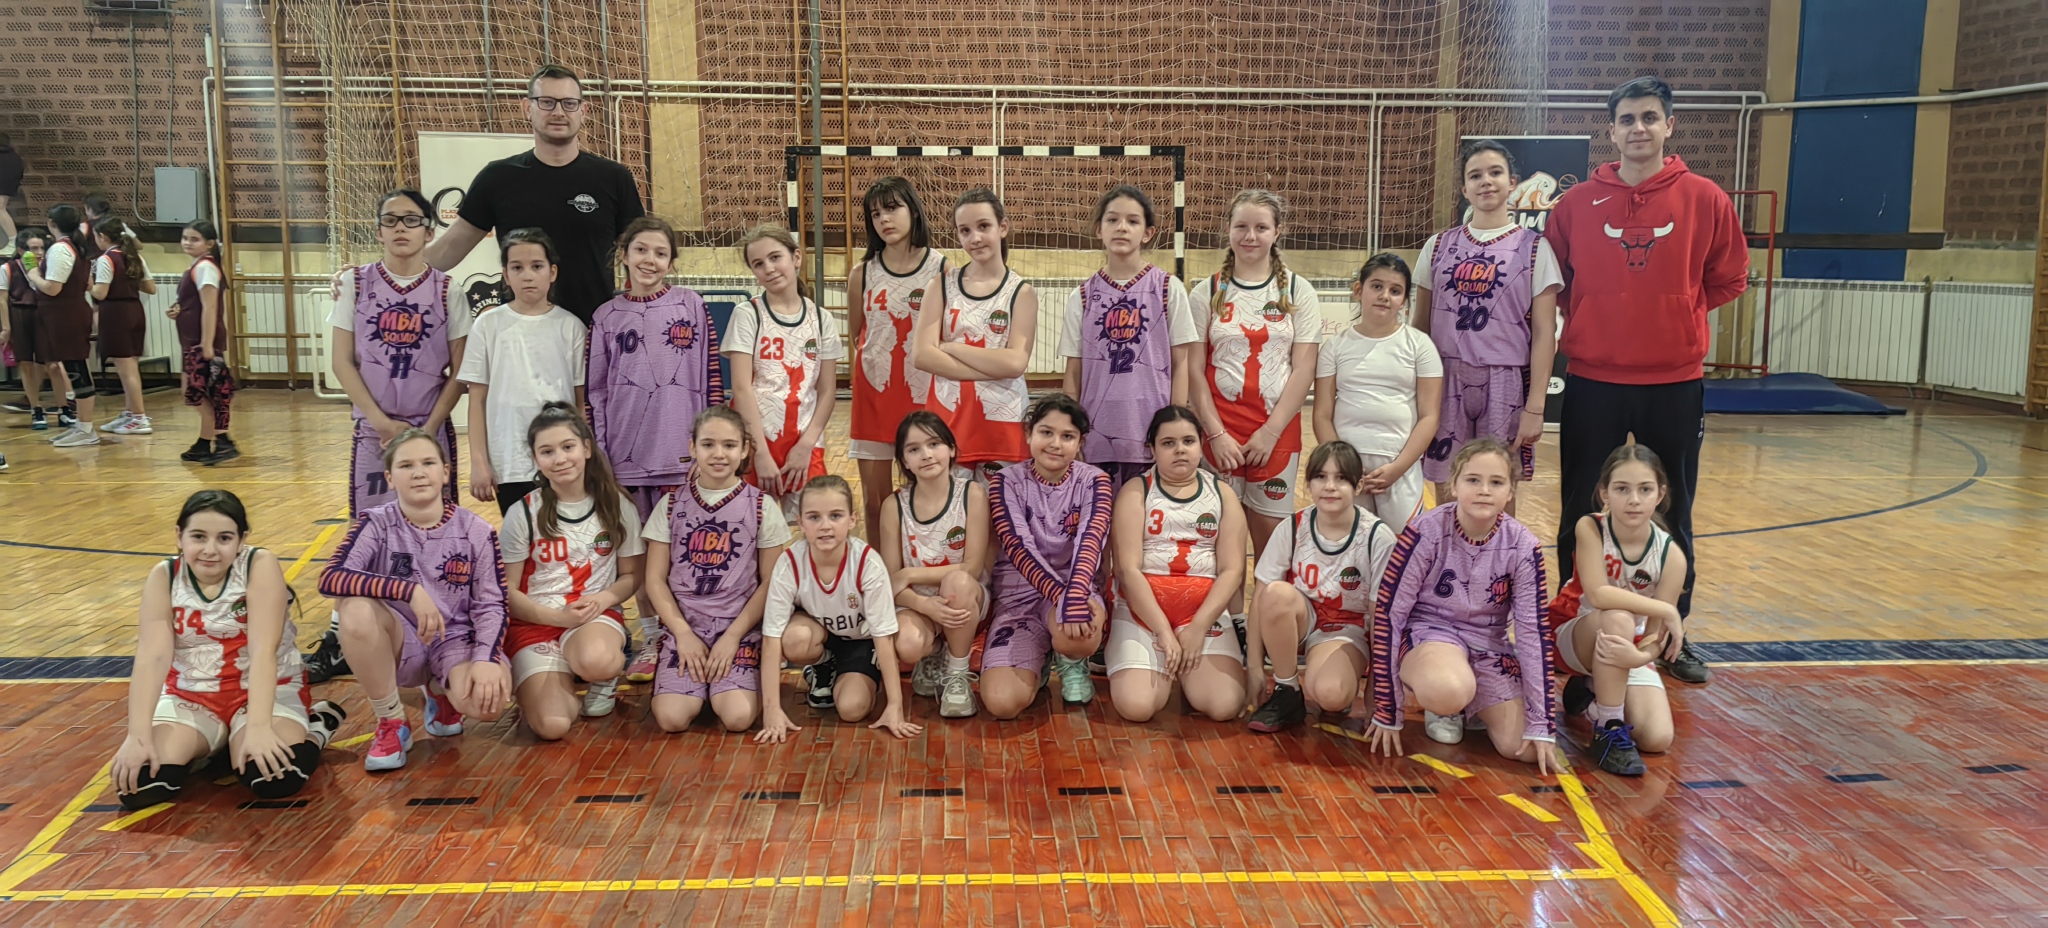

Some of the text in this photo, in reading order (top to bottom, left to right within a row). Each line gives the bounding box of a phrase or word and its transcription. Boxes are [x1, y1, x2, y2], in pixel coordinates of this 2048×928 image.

[1454, 262, 1497, 281] MBA
[1457, 281, 1489, 293] SQUAD
[866, 289, 888, 311] 14
[380, 311, 422, 332] MBA
[949, 309, 961, 333] 7
[1105, 308, 1141, 328] MBA
[1456, 305, 1489, 332] 20
[383, 331, 418, 344] SQUAD
[615, 329, 639, 356] 10
[670, 325, 694, 338] MBA
[1110, 328, 1137, 339] QUAD
[760, 336, 785, 360] 23
[1108, 348, 1136, 375] 12
[1064, 512, 1080, 526] MB
[1148, 509, 1164, 535] 3
[537, 536, 569, 563] 30
[688, 531, 731, 553] MBA
[389, 552, 414, 580] 13
[445, 560, 472, 574] MBA
[691, 552, 725, 565] SQUAD
[1605, 553, 1622, 580] 37
[1433, 569, 1457, 598] 6
[172, 606, 208, 636] 34
[814, 612, 867, 632] RBIA
[990, 626, 1015, 649] 2
